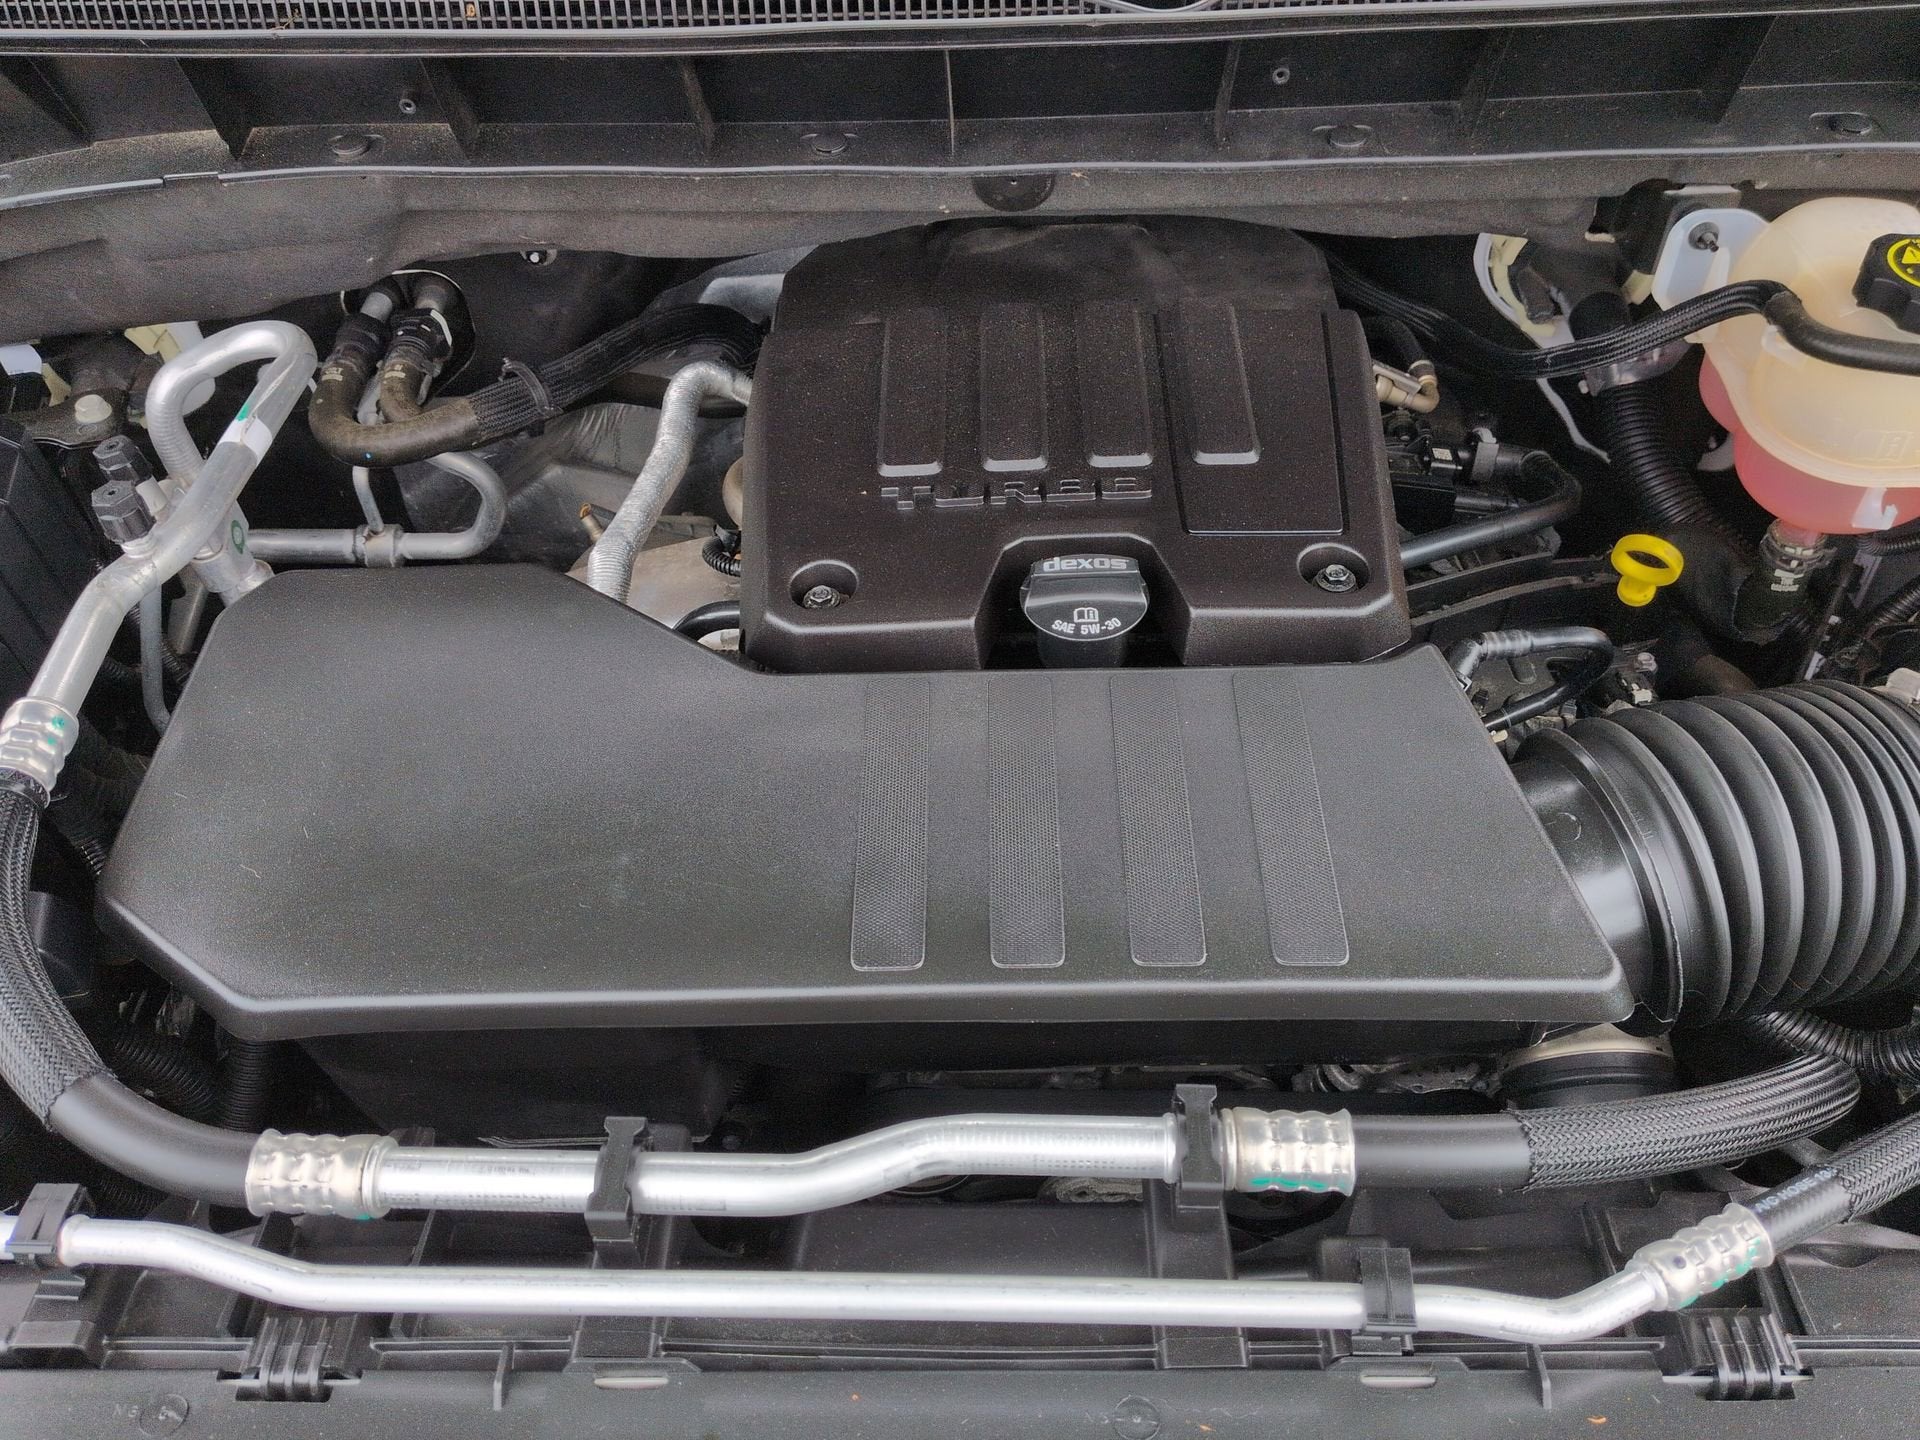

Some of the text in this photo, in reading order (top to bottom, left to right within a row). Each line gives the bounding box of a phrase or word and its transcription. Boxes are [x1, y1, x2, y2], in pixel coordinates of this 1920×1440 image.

[1043, 556, 1128, 572] dexos
[1051, 617, 1122, 635] SAE 5W-30
[1777, 1177, 1817, 1200] HOSE
